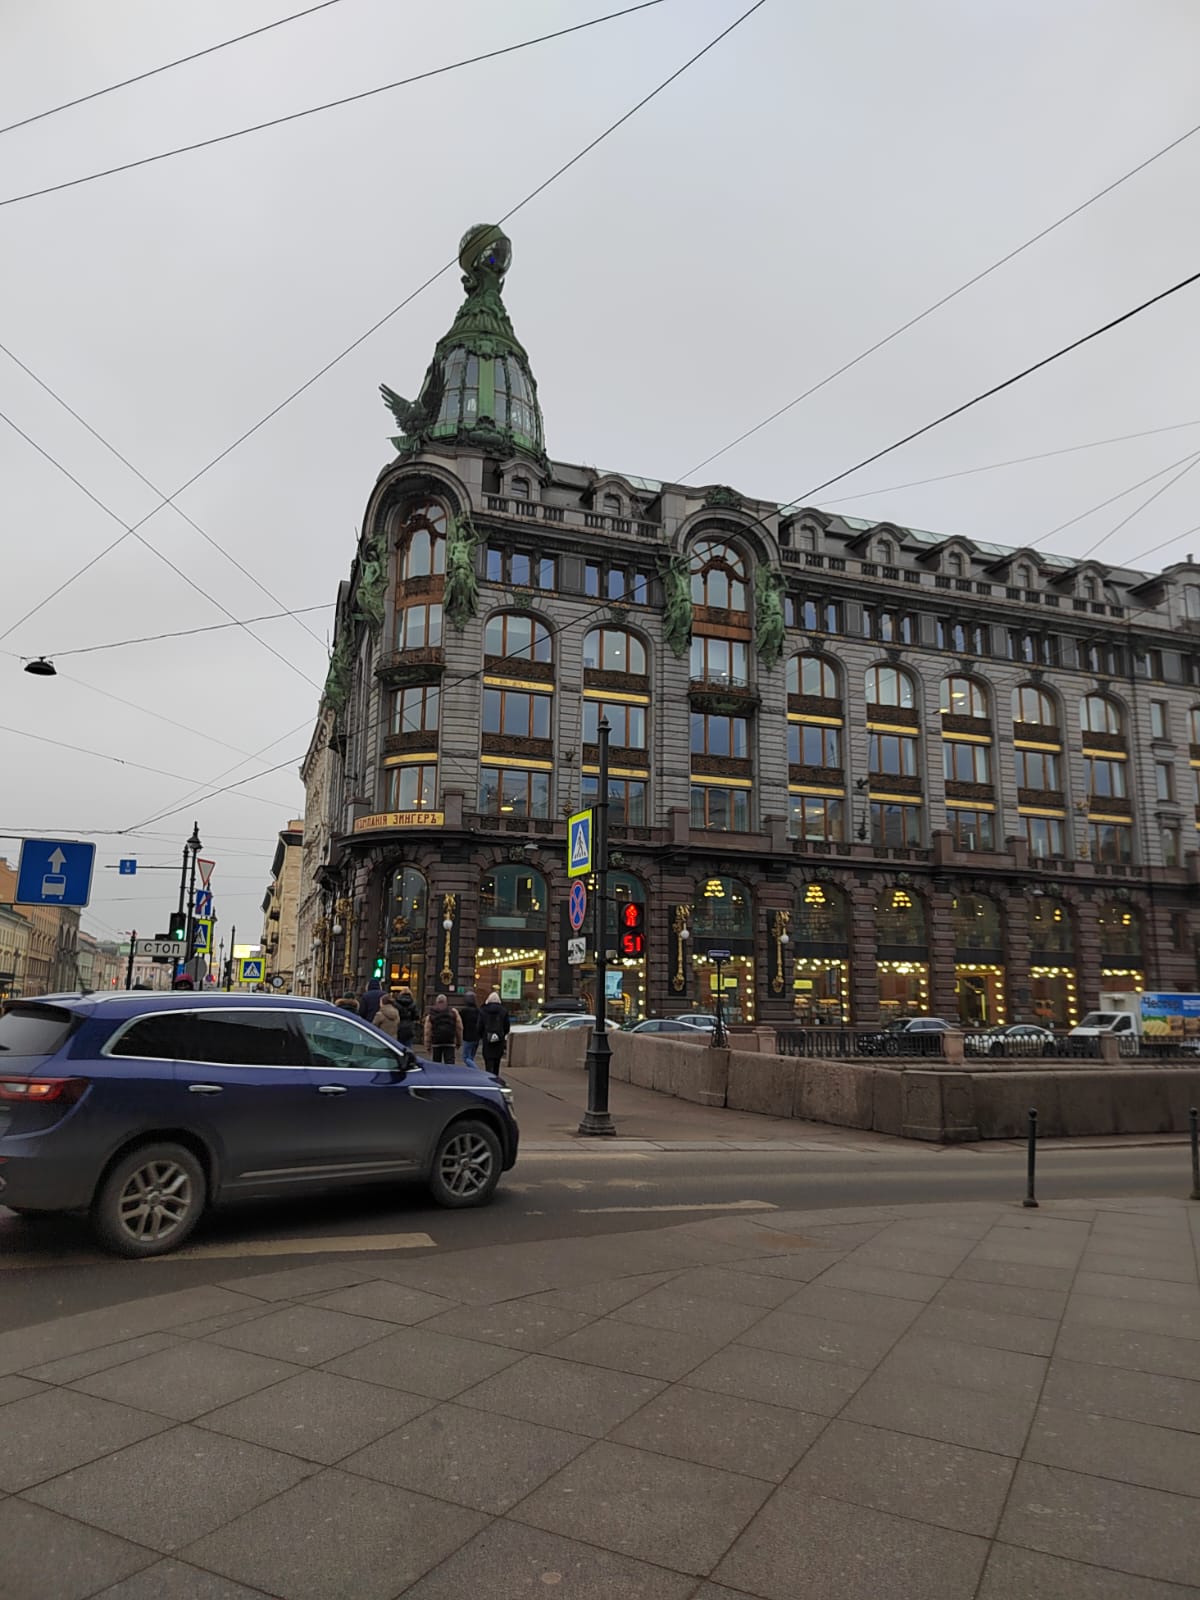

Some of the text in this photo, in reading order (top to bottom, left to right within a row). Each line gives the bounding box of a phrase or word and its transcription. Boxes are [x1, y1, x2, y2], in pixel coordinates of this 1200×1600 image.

[393, 813, 437, 825] ЗИНГЕРЪ
[144, 942, 180, 955] СТОП
[623, 934, 641, 952] 51
